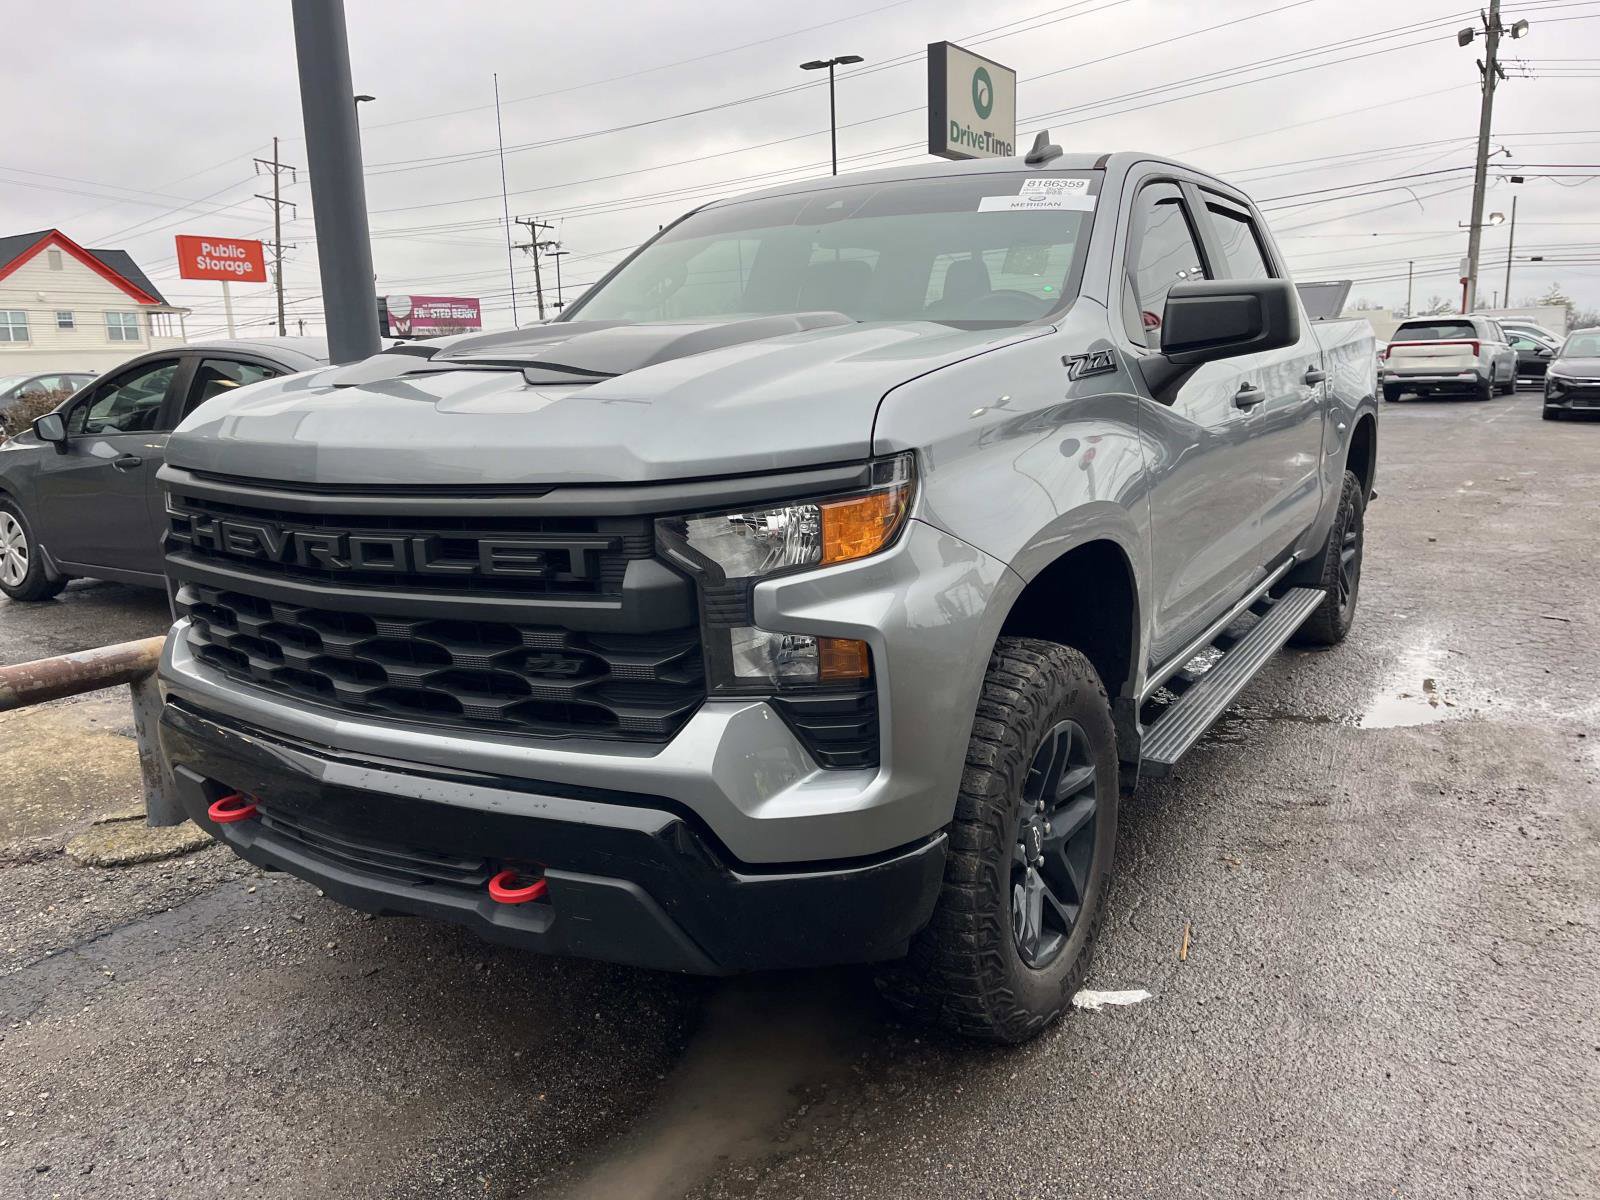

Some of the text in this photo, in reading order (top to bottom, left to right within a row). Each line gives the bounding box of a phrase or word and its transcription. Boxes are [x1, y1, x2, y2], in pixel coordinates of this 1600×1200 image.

[949, 120, 1012, 157] DriveTime
[1027, 180, 1085, 188] 8186359
[201, 242, 246, 258] Public
[196, 256, 253, 275] Storage
